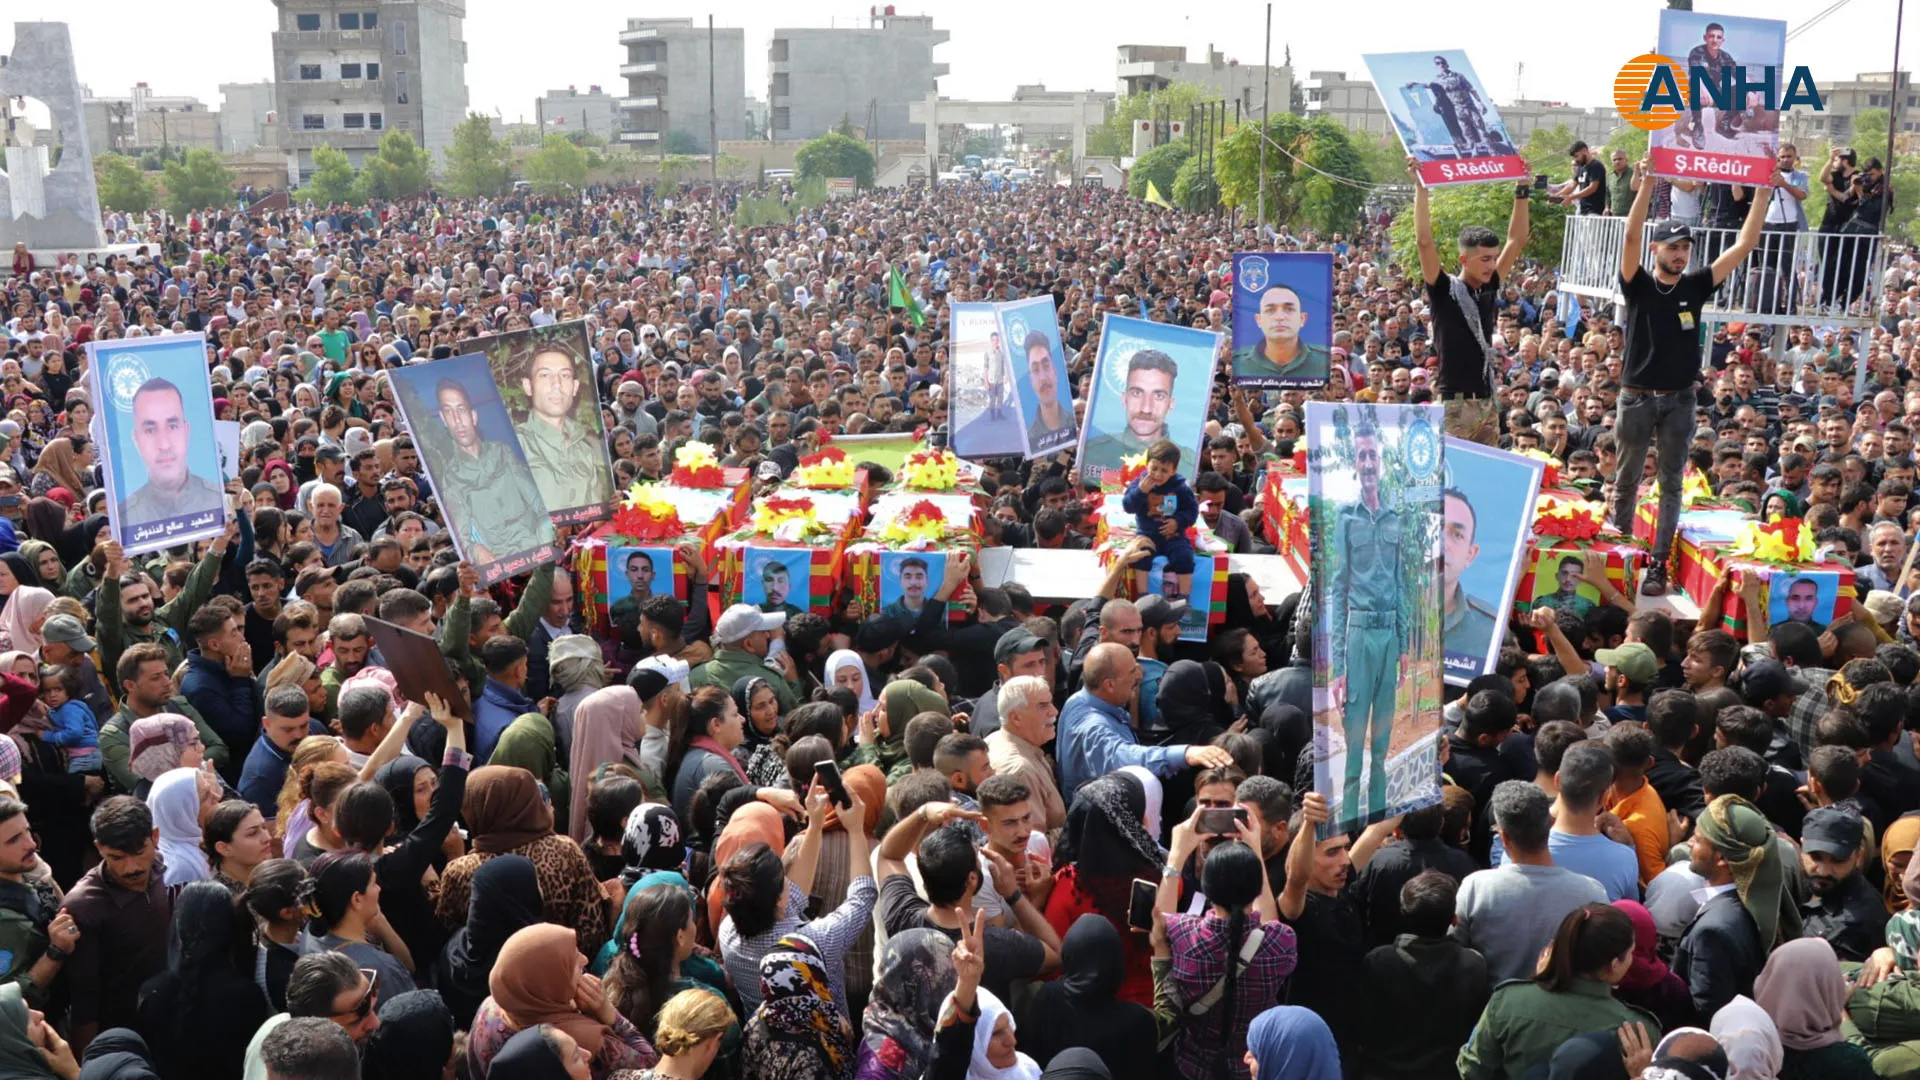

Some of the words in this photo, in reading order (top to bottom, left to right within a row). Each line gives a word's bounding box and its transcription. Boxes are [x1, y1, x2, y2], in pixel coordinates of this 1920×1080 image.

[1440, 160, 1504, 181] Ş.Rêdûr
[1674, 154, 1752, 177] Ş.Rêdûr
[190, 512, 215, 528] الشهيد
